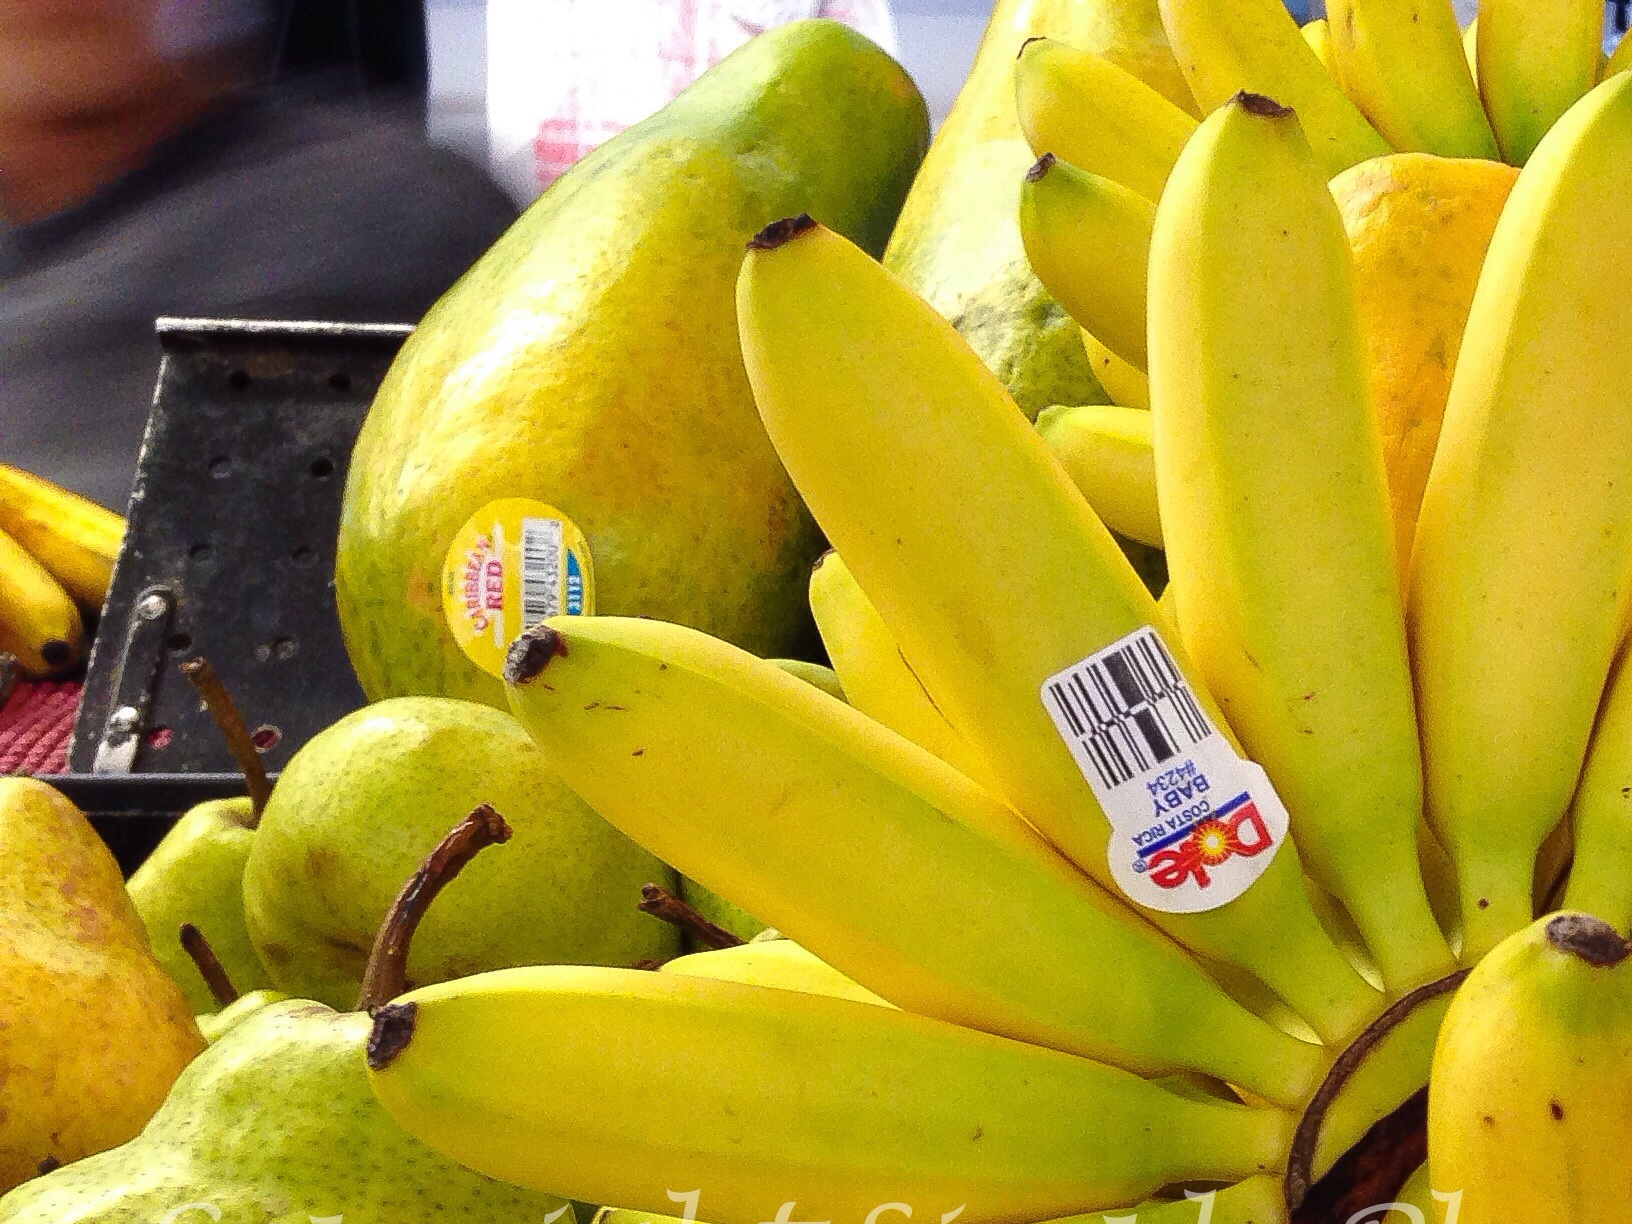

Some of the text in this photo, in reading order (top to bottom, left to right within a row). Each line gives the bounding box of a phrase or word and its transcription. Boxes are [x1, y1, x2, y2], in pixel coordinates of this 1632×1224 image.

[486, 560, 503, 610] RED
[1146, 759, 1197, 795] #4234
[1152, 773, 1210, 818] BABY
[1131, 800, 1210, 847] COSTA RICA
[1150, 801, 1273, 888] Dole
